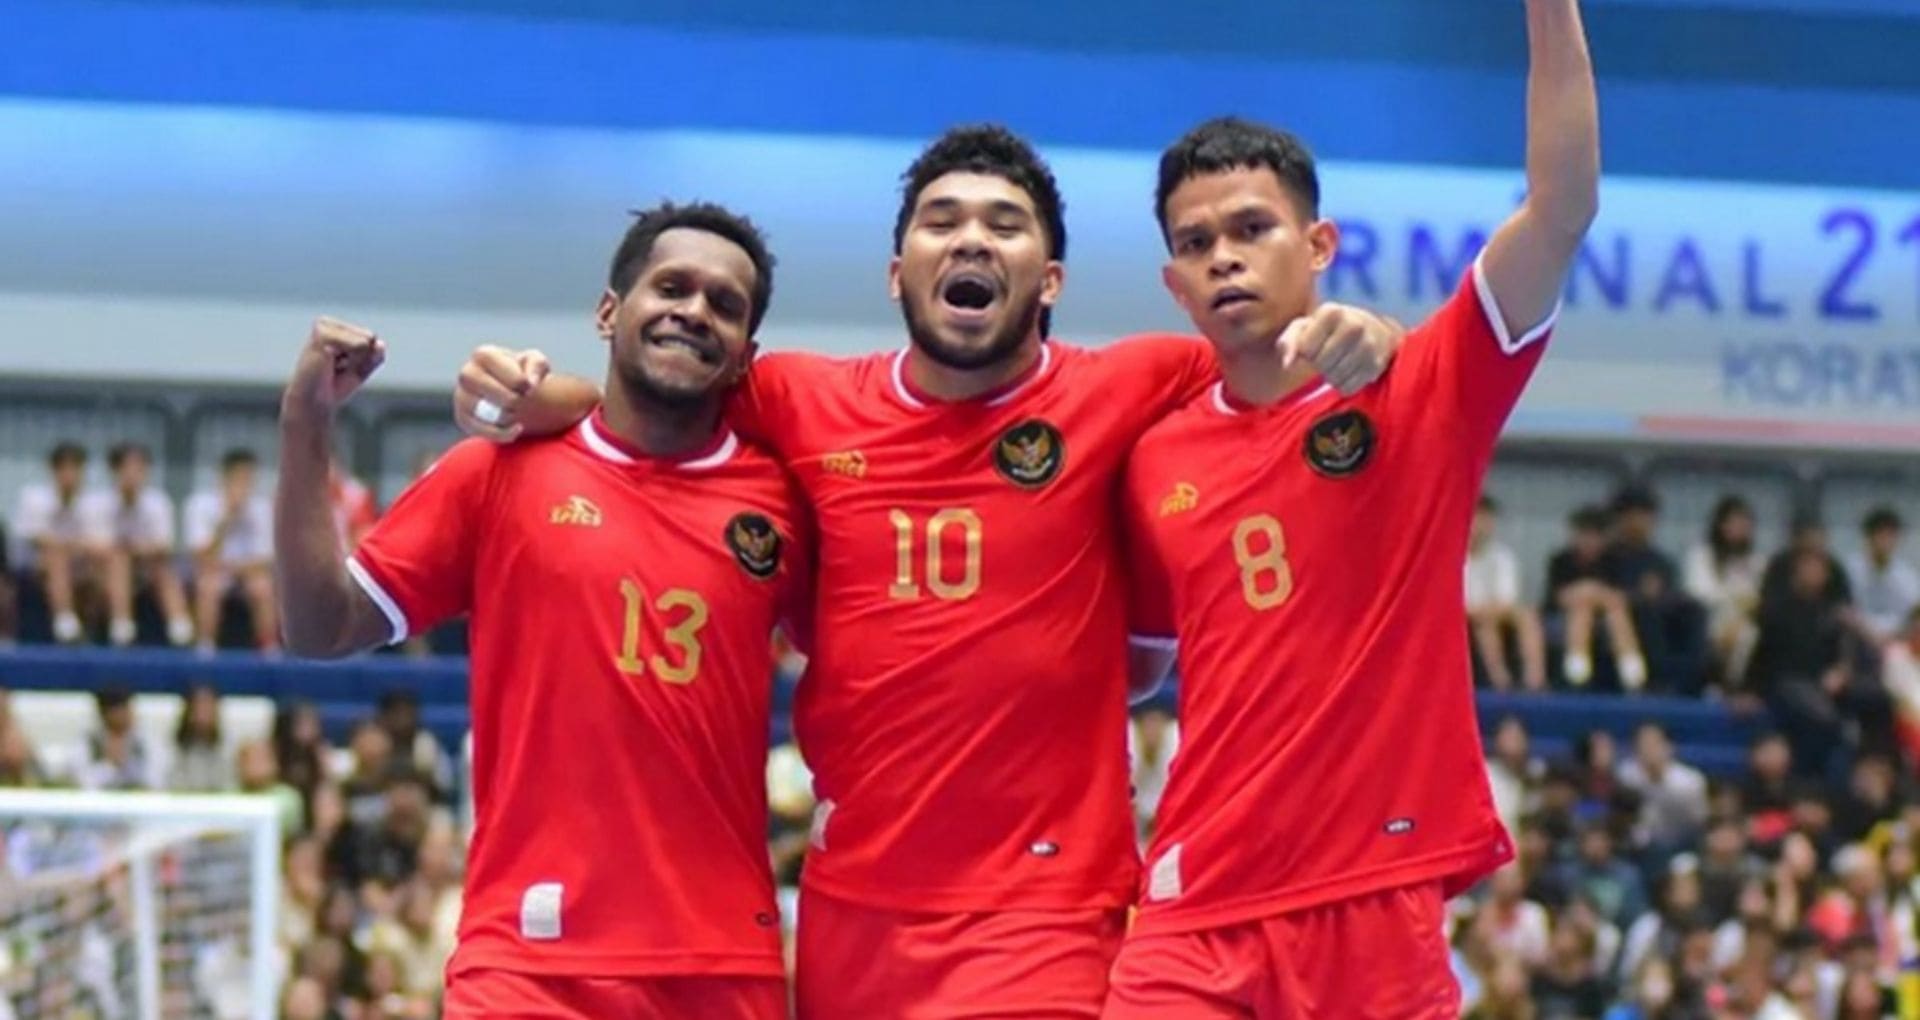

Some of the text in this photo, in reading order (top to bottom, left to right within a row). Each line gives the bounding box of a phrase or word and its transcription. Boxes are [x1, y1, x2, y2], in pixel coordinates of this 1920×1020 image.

[1817, 208, 1920, 322] 2
[889, 508, 982, 600] 10
[1232, 513, 1293, 610] 8
[615, 578, 709, 685] 13
